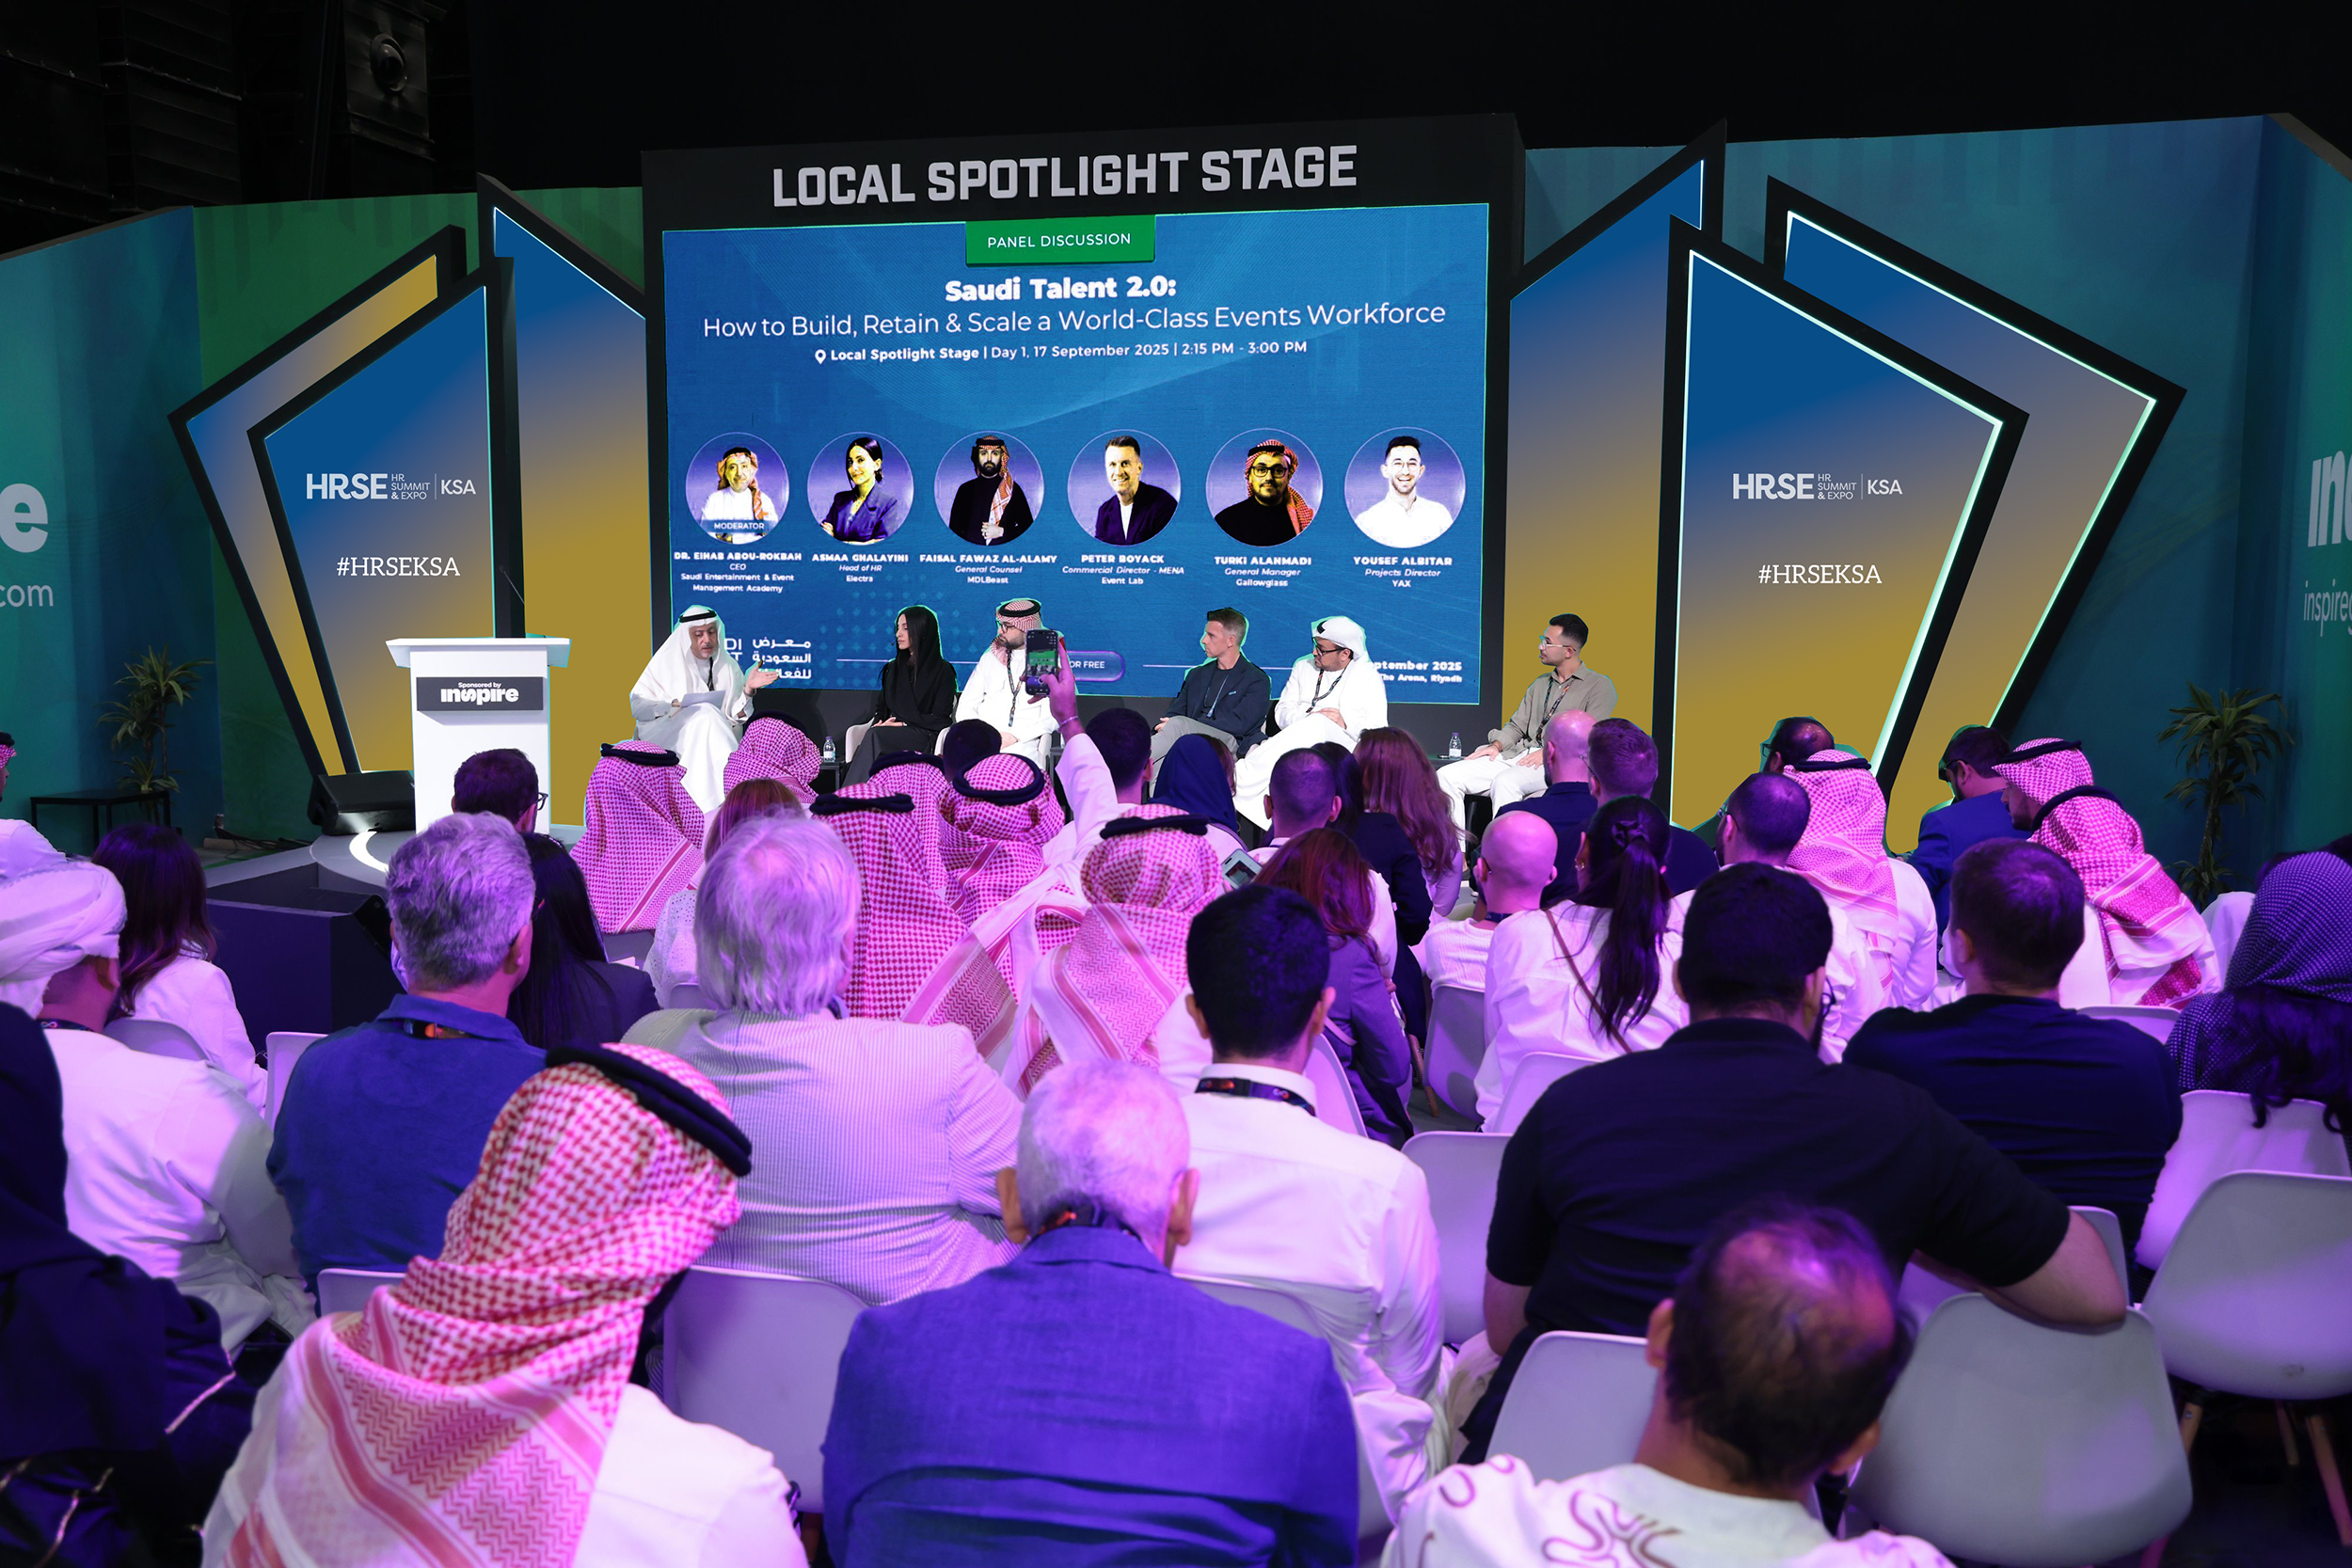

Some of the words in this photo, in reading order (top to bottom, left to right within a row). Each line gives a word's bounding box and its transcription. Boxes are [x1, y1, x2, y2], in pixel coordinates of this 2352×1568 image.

[773, 164, 915, 207] LOCAL
[929, 152, 1188, 200] SPOTLIGHT
[1202, 145, 1357, 191] STAGE
[988, 236, 1035, 247] PANEL
[1041, 233, 1130, 246] DISCUSSION
[946, 277, 1021, 301] Saudi
[1029, 277, 1118, 299] Talent
[1127, 276, 1176, 297] 2.0:
[705, 319, 756, 337] How
[761, 319, 785, 336] to
[793, 315, 857, 338] Build,
[865, 313, 938, 334] Retain
[946, 313, 961, 332] &
[968, 311, 1031, 332] Scale
[1039, 316, 1050, 330] a
[1059, 308, 1208, 330] World-Class
[1216, 307, 1300, 326] Events
[1308, 302, 1445, 325] Workforce
[832, 349, 866, 360] Local
[870, 348, 935, 362] Spotlight
[940, 348, 979, 361] Stage
[992, 347, 1017, 360] Day
[1022, 346, 1029, 357] 1,
[1034, 346, 1047, 356] 17
[1052, 345, 1130, 358] September
[1135, 344, 1168, 356] 2025
[1183, 343, 1207, 355] 2:15
[1212, 343, 1233, 354] PM
[1248, 342, 1279, 354] 3:00
[1285, 341, 1307, 353] PM
[307, 473, 388, 499] HRSE
[441, 480, 476, 495] KSA
[1733, 473, 1814, 499] HRSE
[1868, 480, 1902, 495] KSA
[727, 552, 802, 561] ABOU-ROKBAH
[1402, 557, 1452, 565] ALBITAR
[337, 557, 460, 576] #HRSEKSA
[1262, 568, 1300, 578] Manager
[1365, 568, 1401, 578] Projects
[1758, 564, 1882, 583] #HRSEKSA
[746, 585, 783, 594] Academy
[1236, 578, 1288, 588] Gallowglass
[2304, 578, 2352, 637] inspire
[753, 637, 811, 648] معرض
[1374, 661, 1429, 671] ptember
[1432, 661, 1462, 671] 2025
[1397, 674, 1427, 683] Arena,
[1431, 674, 1462, 684] Riyadh
[440, 689, 519, 705] inspire
